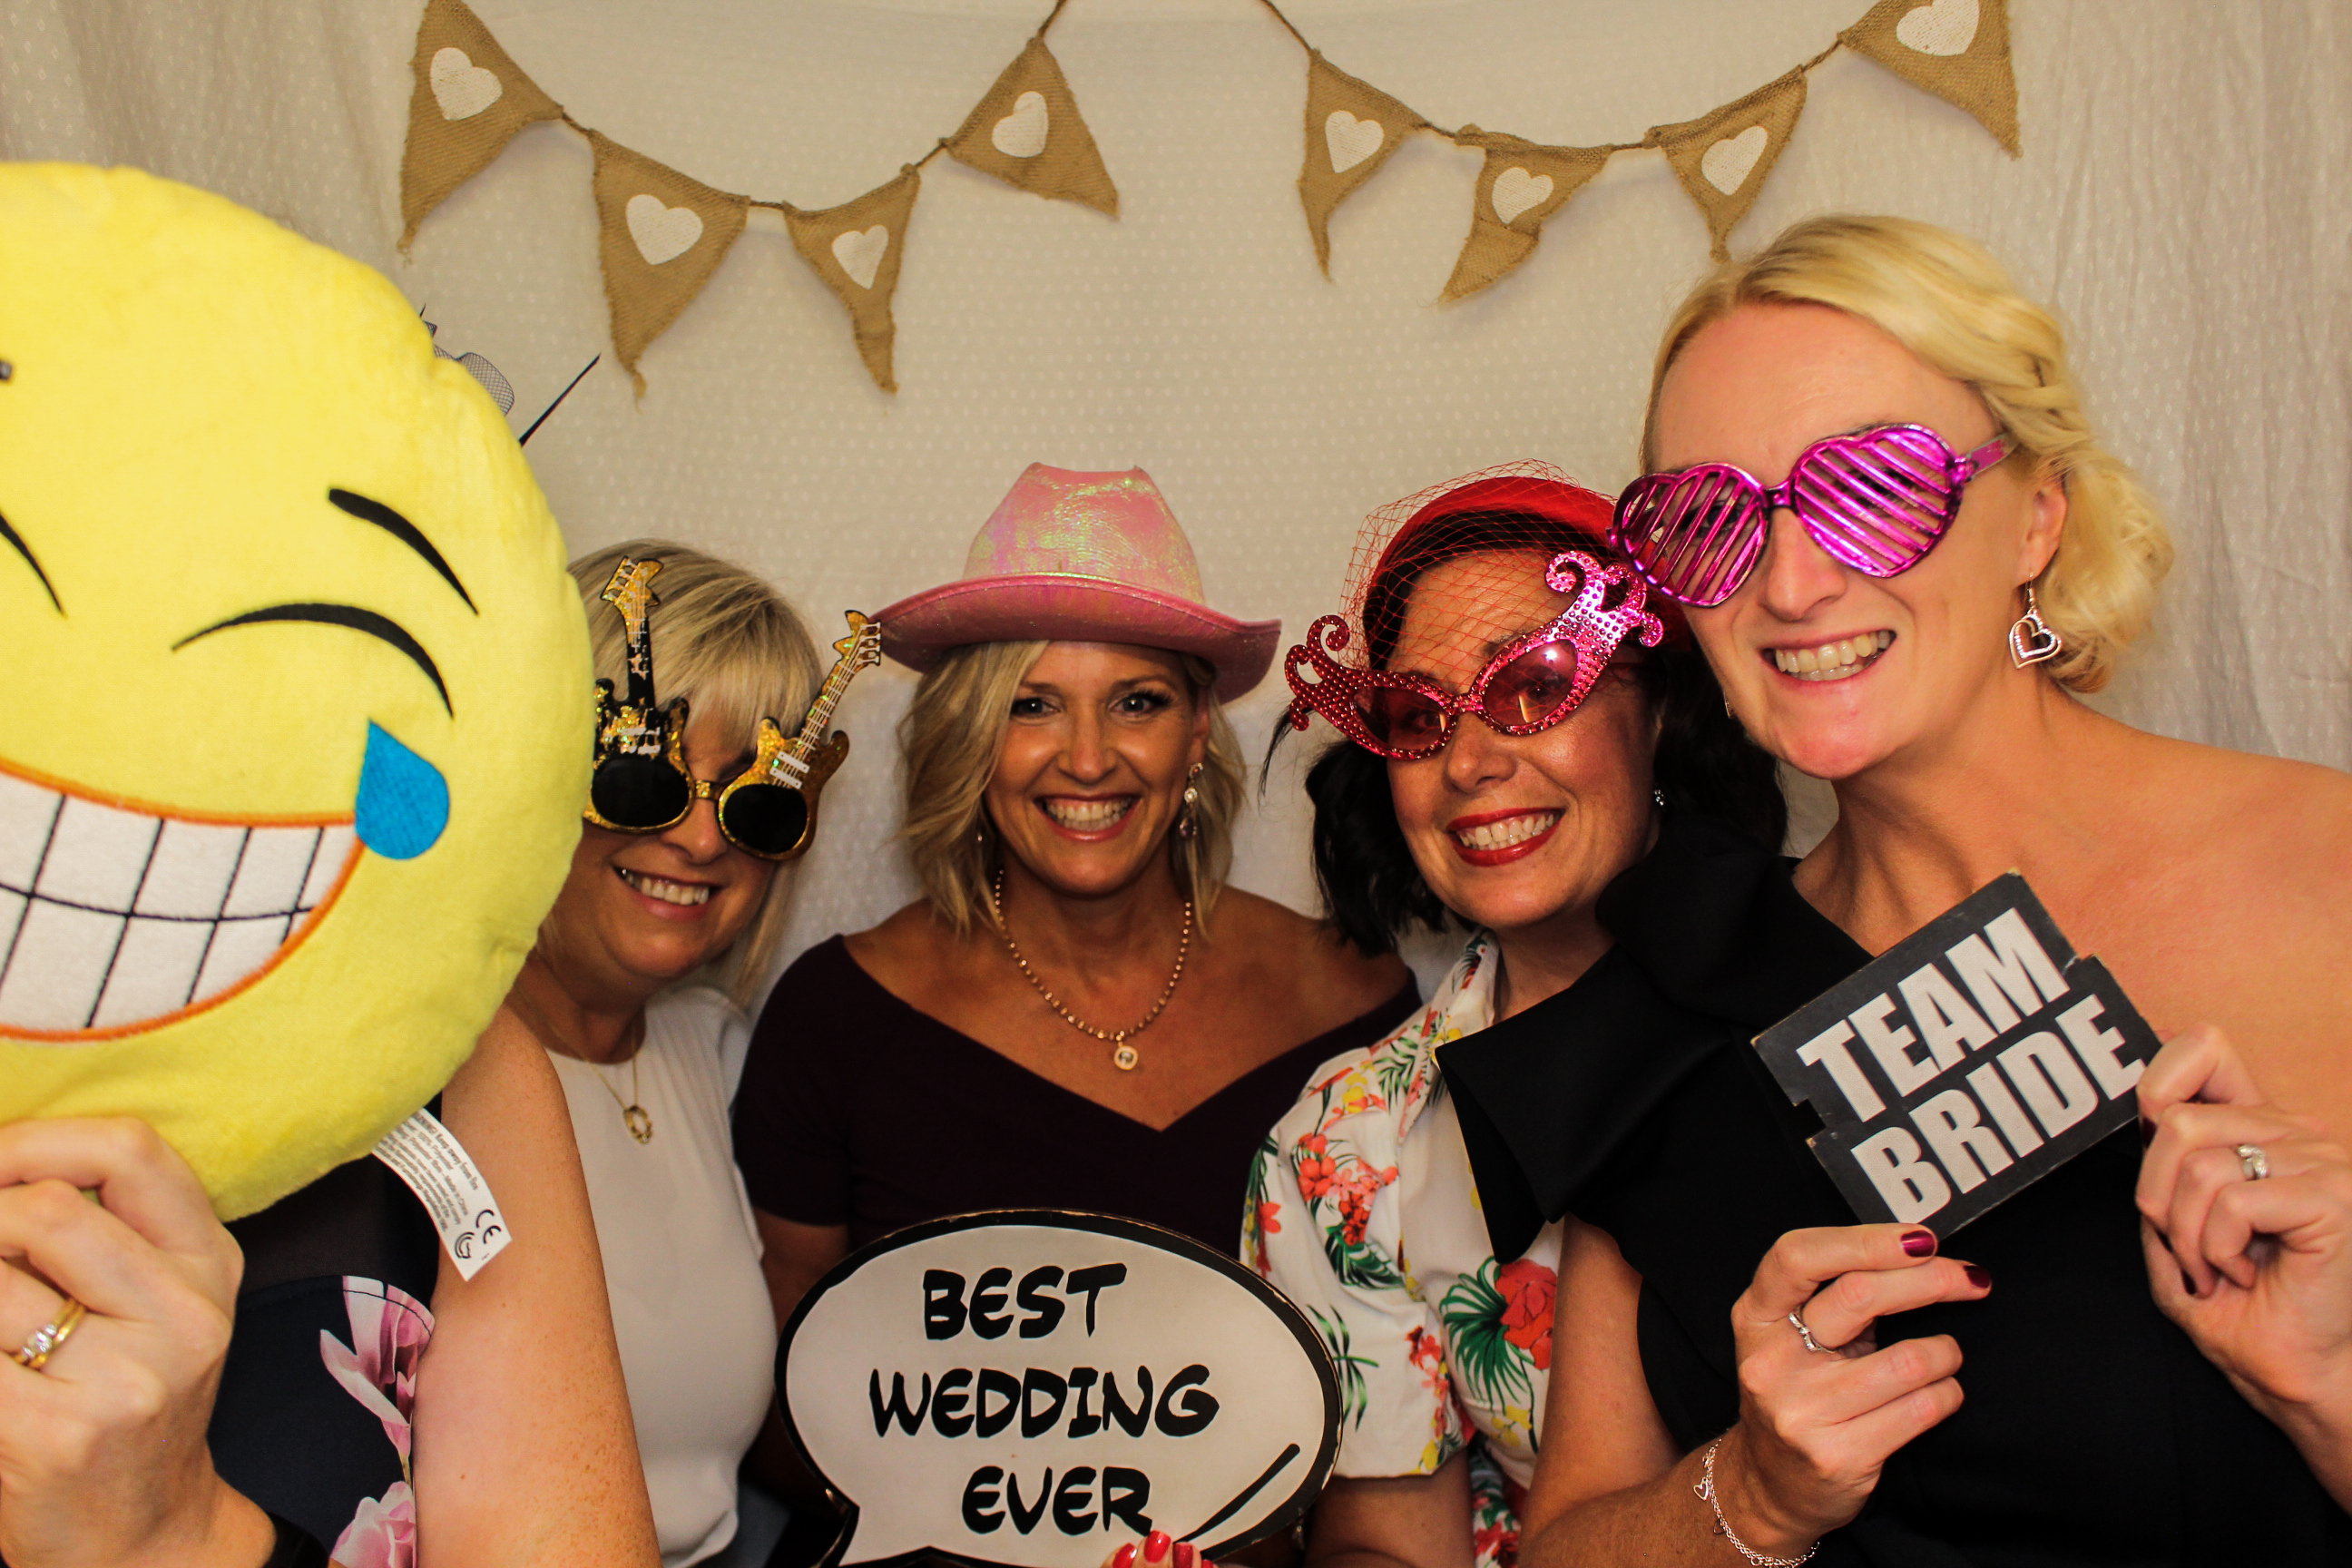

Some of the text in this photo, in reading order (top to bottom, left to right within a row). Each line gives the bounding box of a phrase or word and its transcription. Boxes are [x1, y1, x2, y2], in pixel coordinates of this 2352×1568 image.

[1796, 907, 2071, 1122] TEAM
[1850, 994, 2147, 1224] BRIDE
[923, 1262, 1128, 1340] BEST
[868, 1364, 1220, 1439] WEDDING
[962, 1465, 1153, 1537] EVER
